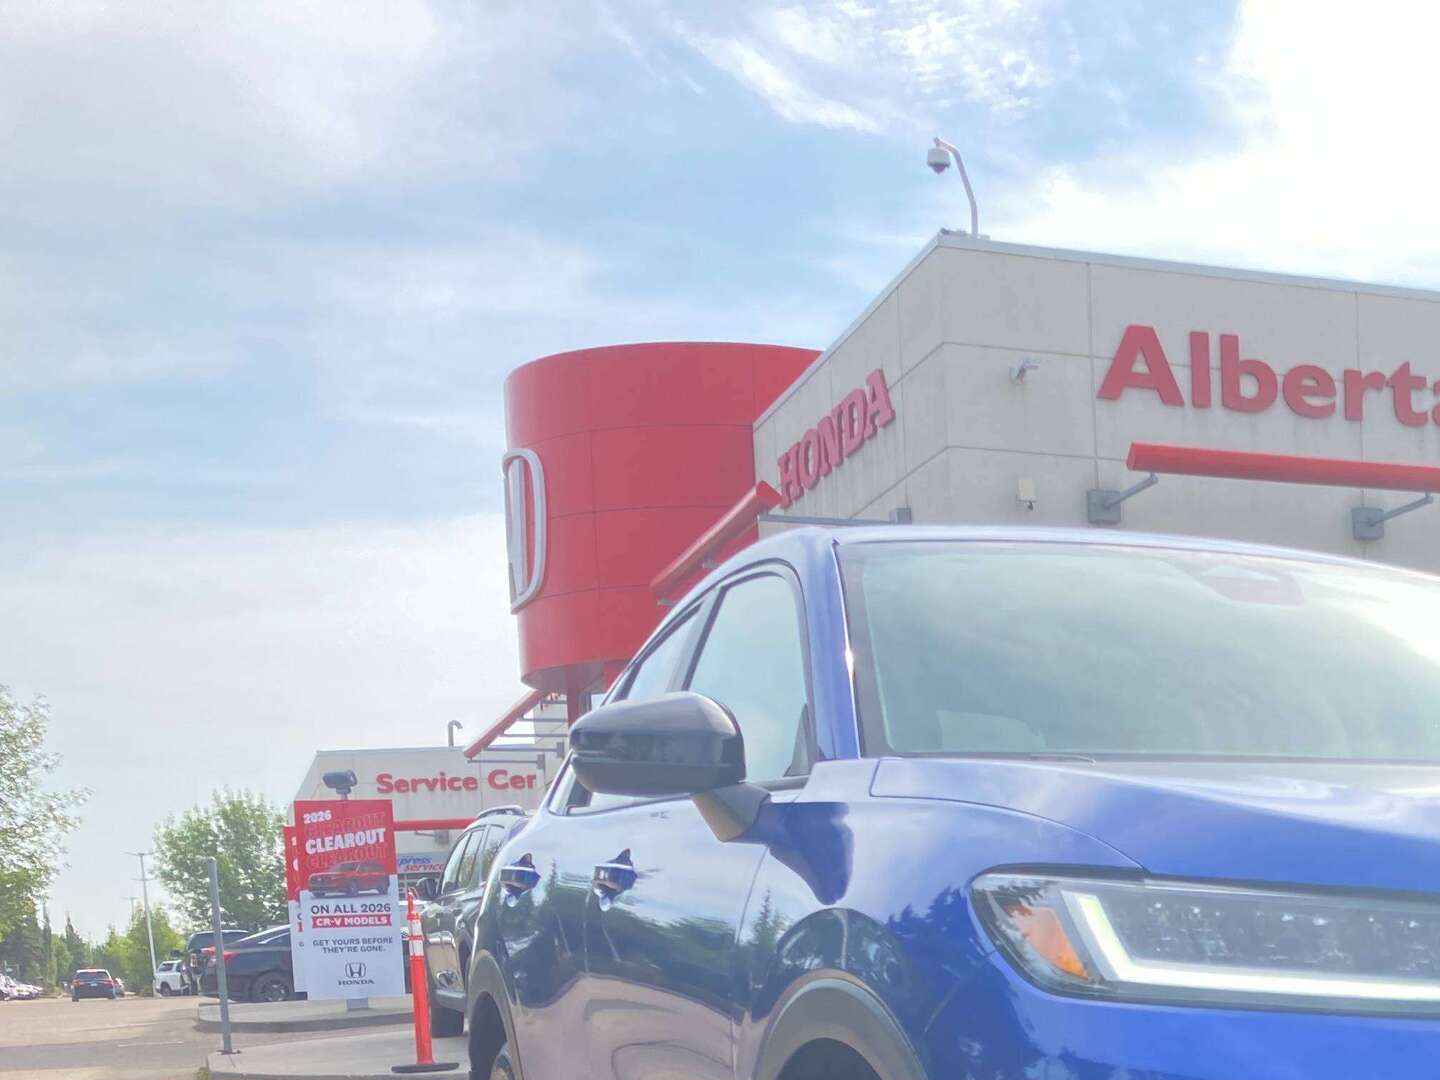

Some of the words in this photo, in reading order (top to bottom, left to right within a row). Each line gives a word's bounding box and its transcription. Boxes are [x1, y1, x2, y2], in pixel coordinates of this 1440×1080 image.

[777, 367, 896, 510] HONDA
[376, 771, 478, 794] Service
[303, 810, 332, 824] 2026
[305, 828, 386, 854] CLEAROUT
[311, 905, 329, 914] ON
[334, 905, 357, 914] ALL
[361, 903, 391, 913] 2026
[316, 918, 341, 926] CR-V
[345, 916, 388, 925] MODELS
